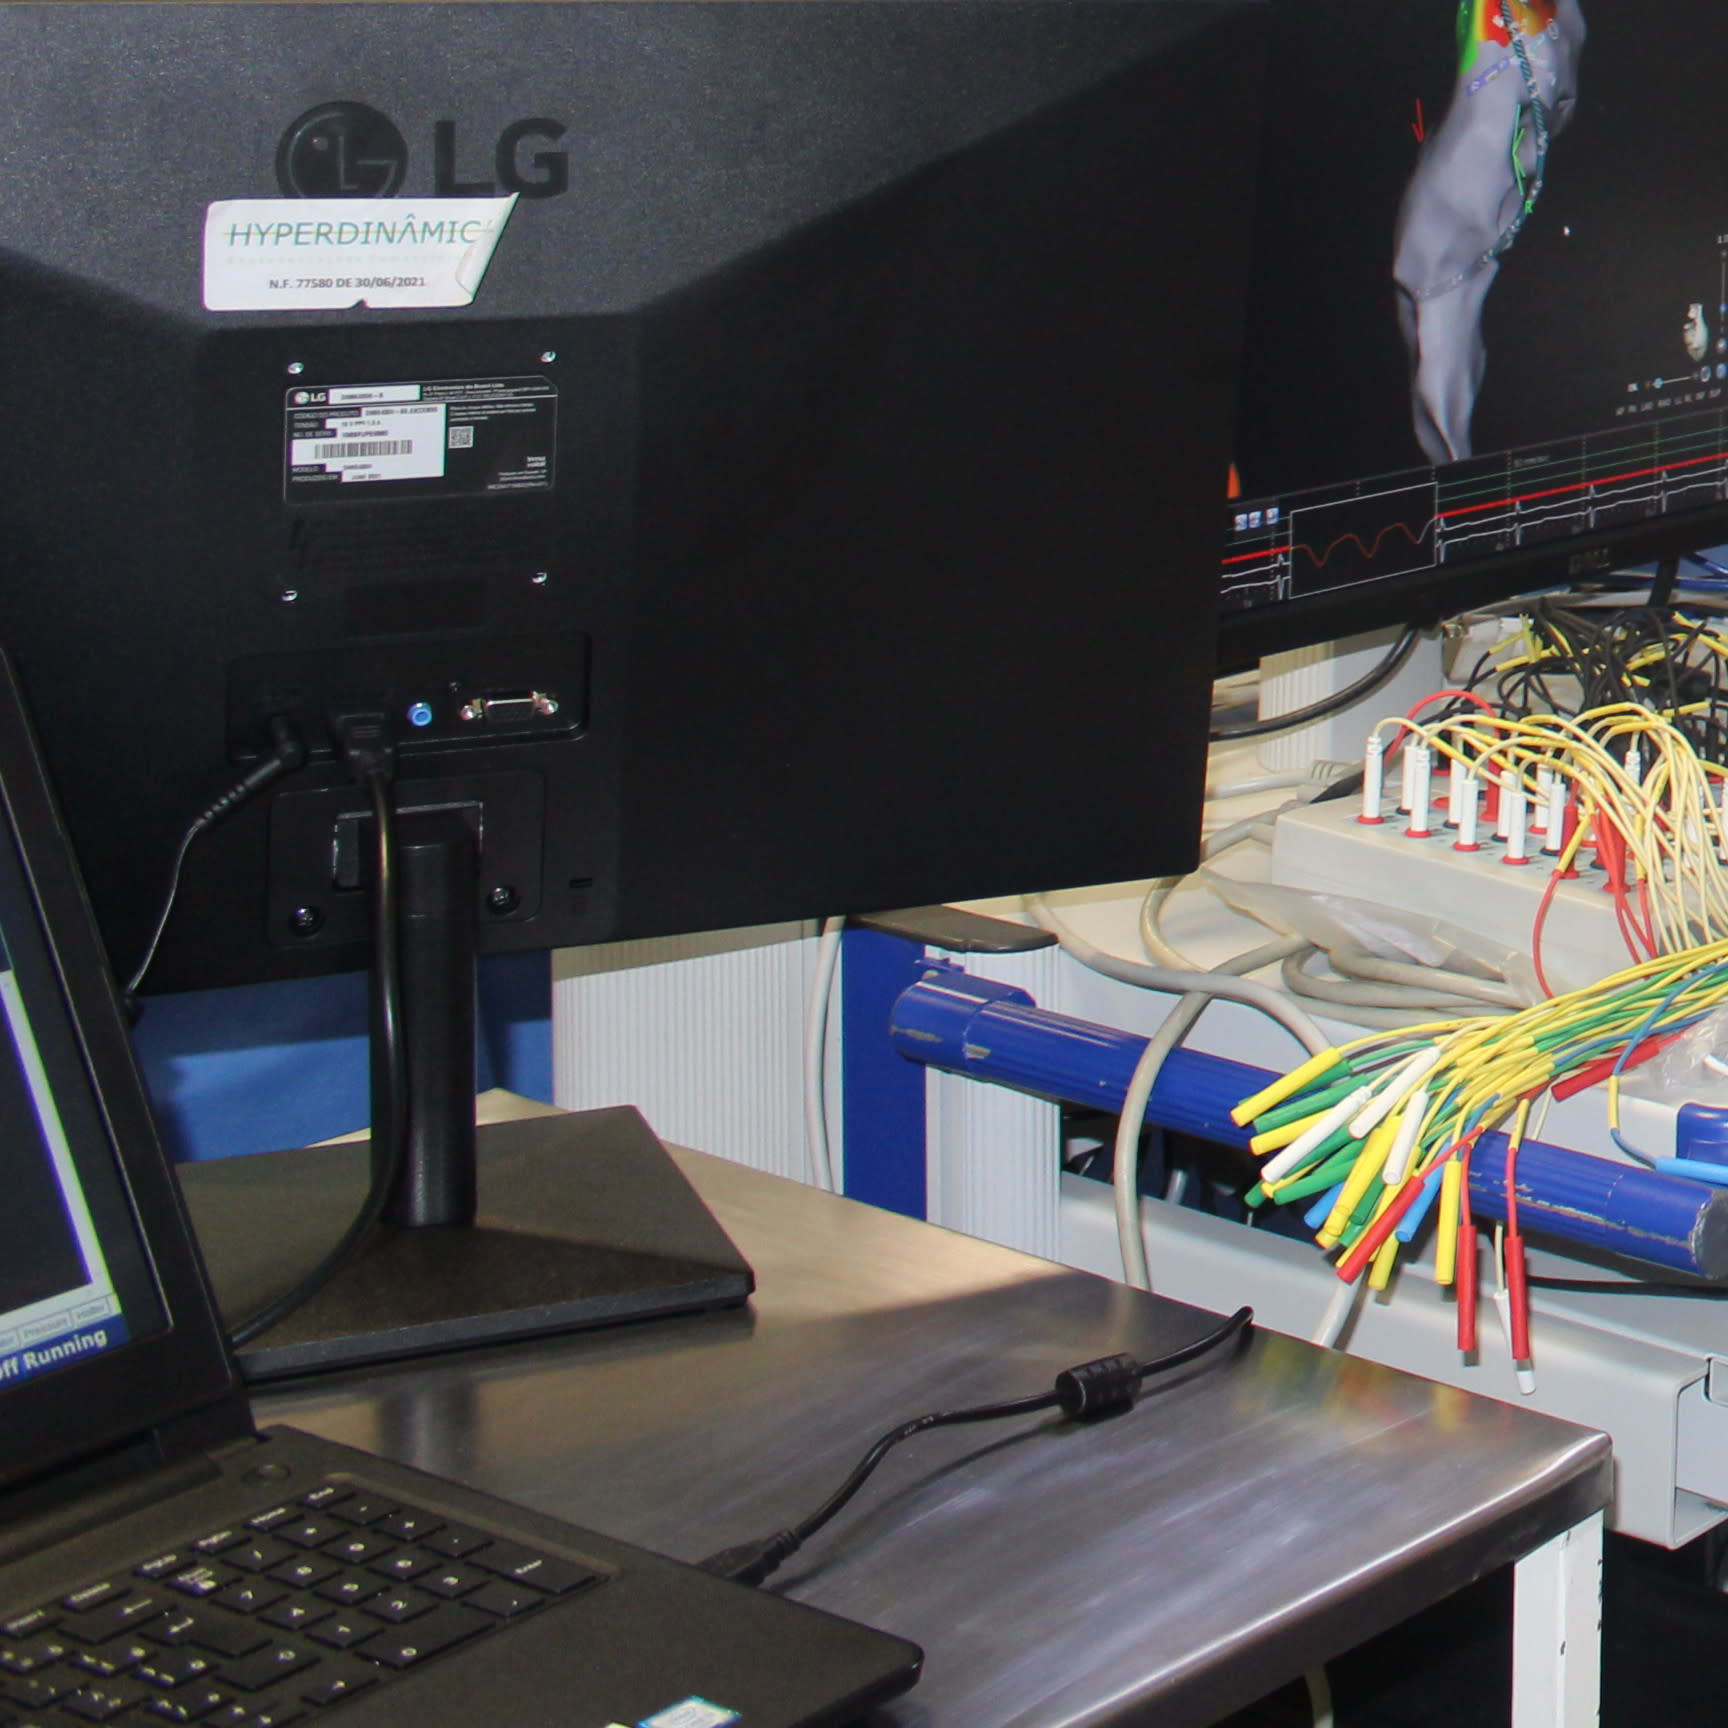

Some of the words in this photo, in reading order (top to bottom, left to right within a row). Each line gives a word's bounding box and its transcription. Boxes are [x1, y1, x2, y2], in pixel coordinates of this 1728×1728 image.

[434, 117, 569, 200] LG
[227, 213, 490, 247] HYPERDINÂMIC
[268, 278, 293, 290] N.F.
[296, 277, 334, 289] 77580
[336, 277, 353, 289] DE
[354, 276, 427, 289] 30/06/2021
[310, 392, 327, 402] LG
[22, 1329, 109, 1371] Running
